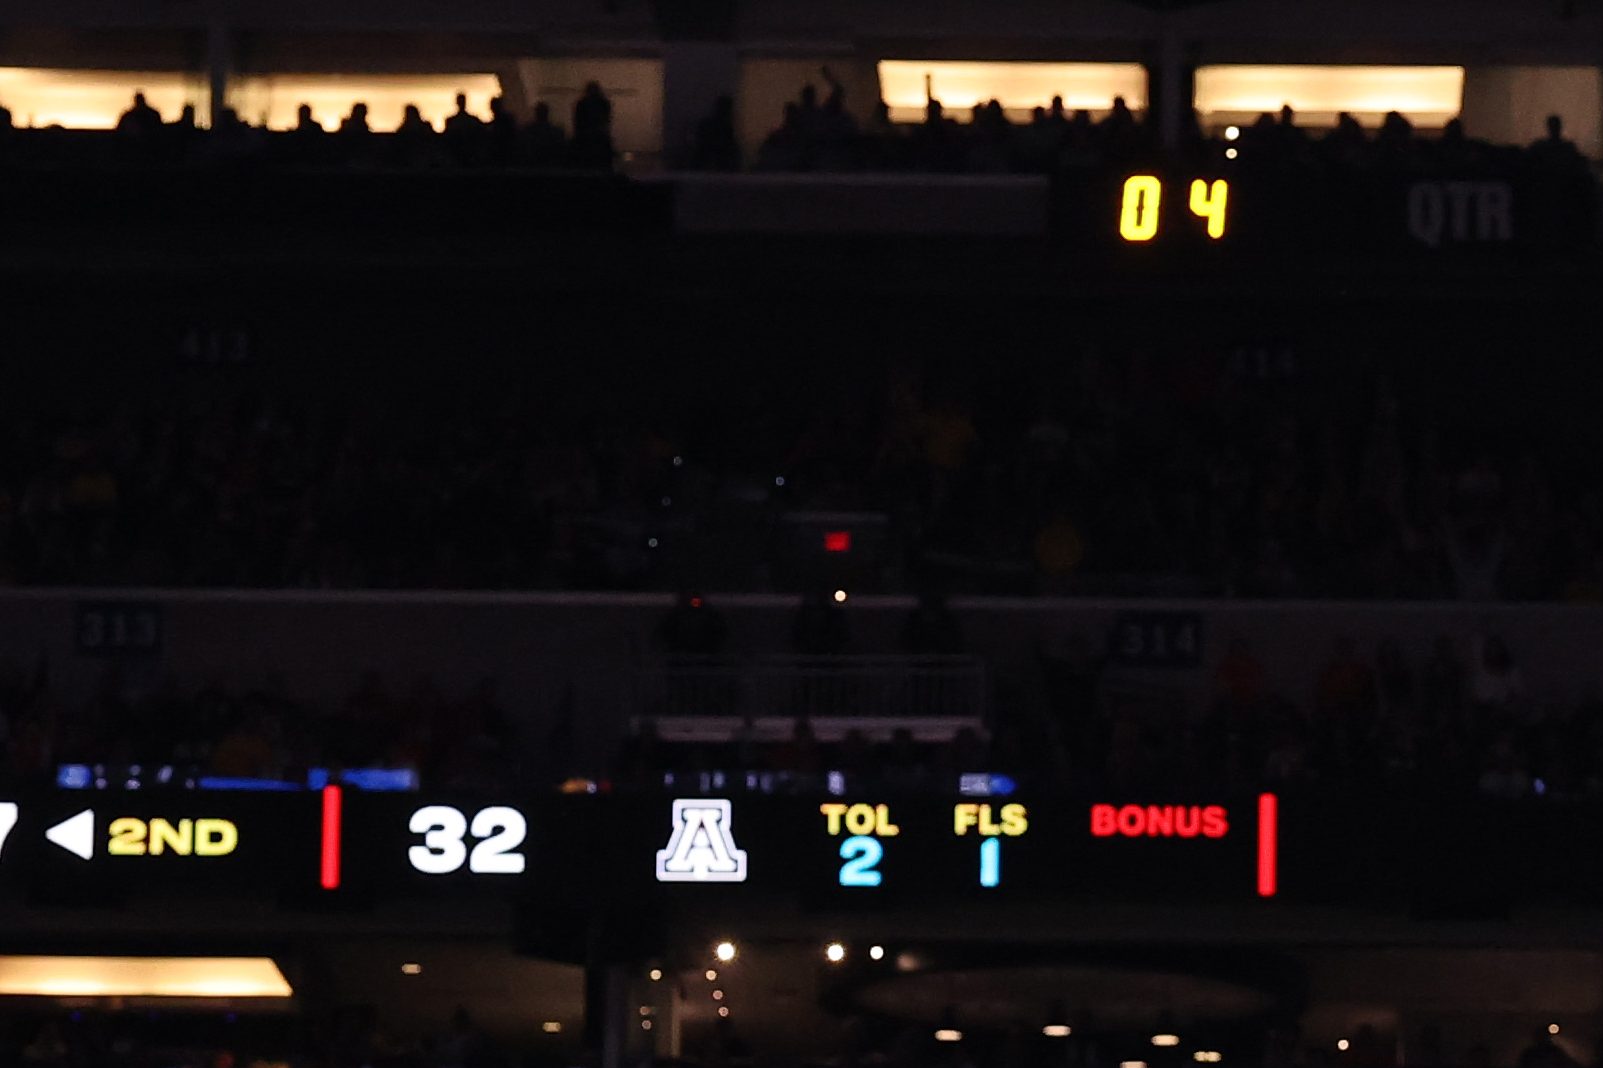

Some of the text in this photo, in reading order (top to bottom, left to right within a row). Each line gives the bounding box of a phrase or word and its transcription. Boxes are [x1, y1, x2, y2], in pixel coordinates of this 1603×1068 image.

[1406, 181, 1513, 247] QTR
[1122, 623, 1197, 658] 314
[107, 817, 238, 856] 2ND
[820, 803, 900, 836] TOL
[954, 803, 1029, 836] FLS
[1090, 803, 1229, 838] BONUS
[408, 805, 527, 874] 32
[838, 836, 884, 887] 2
[979, 836, 1000, 888] 1
